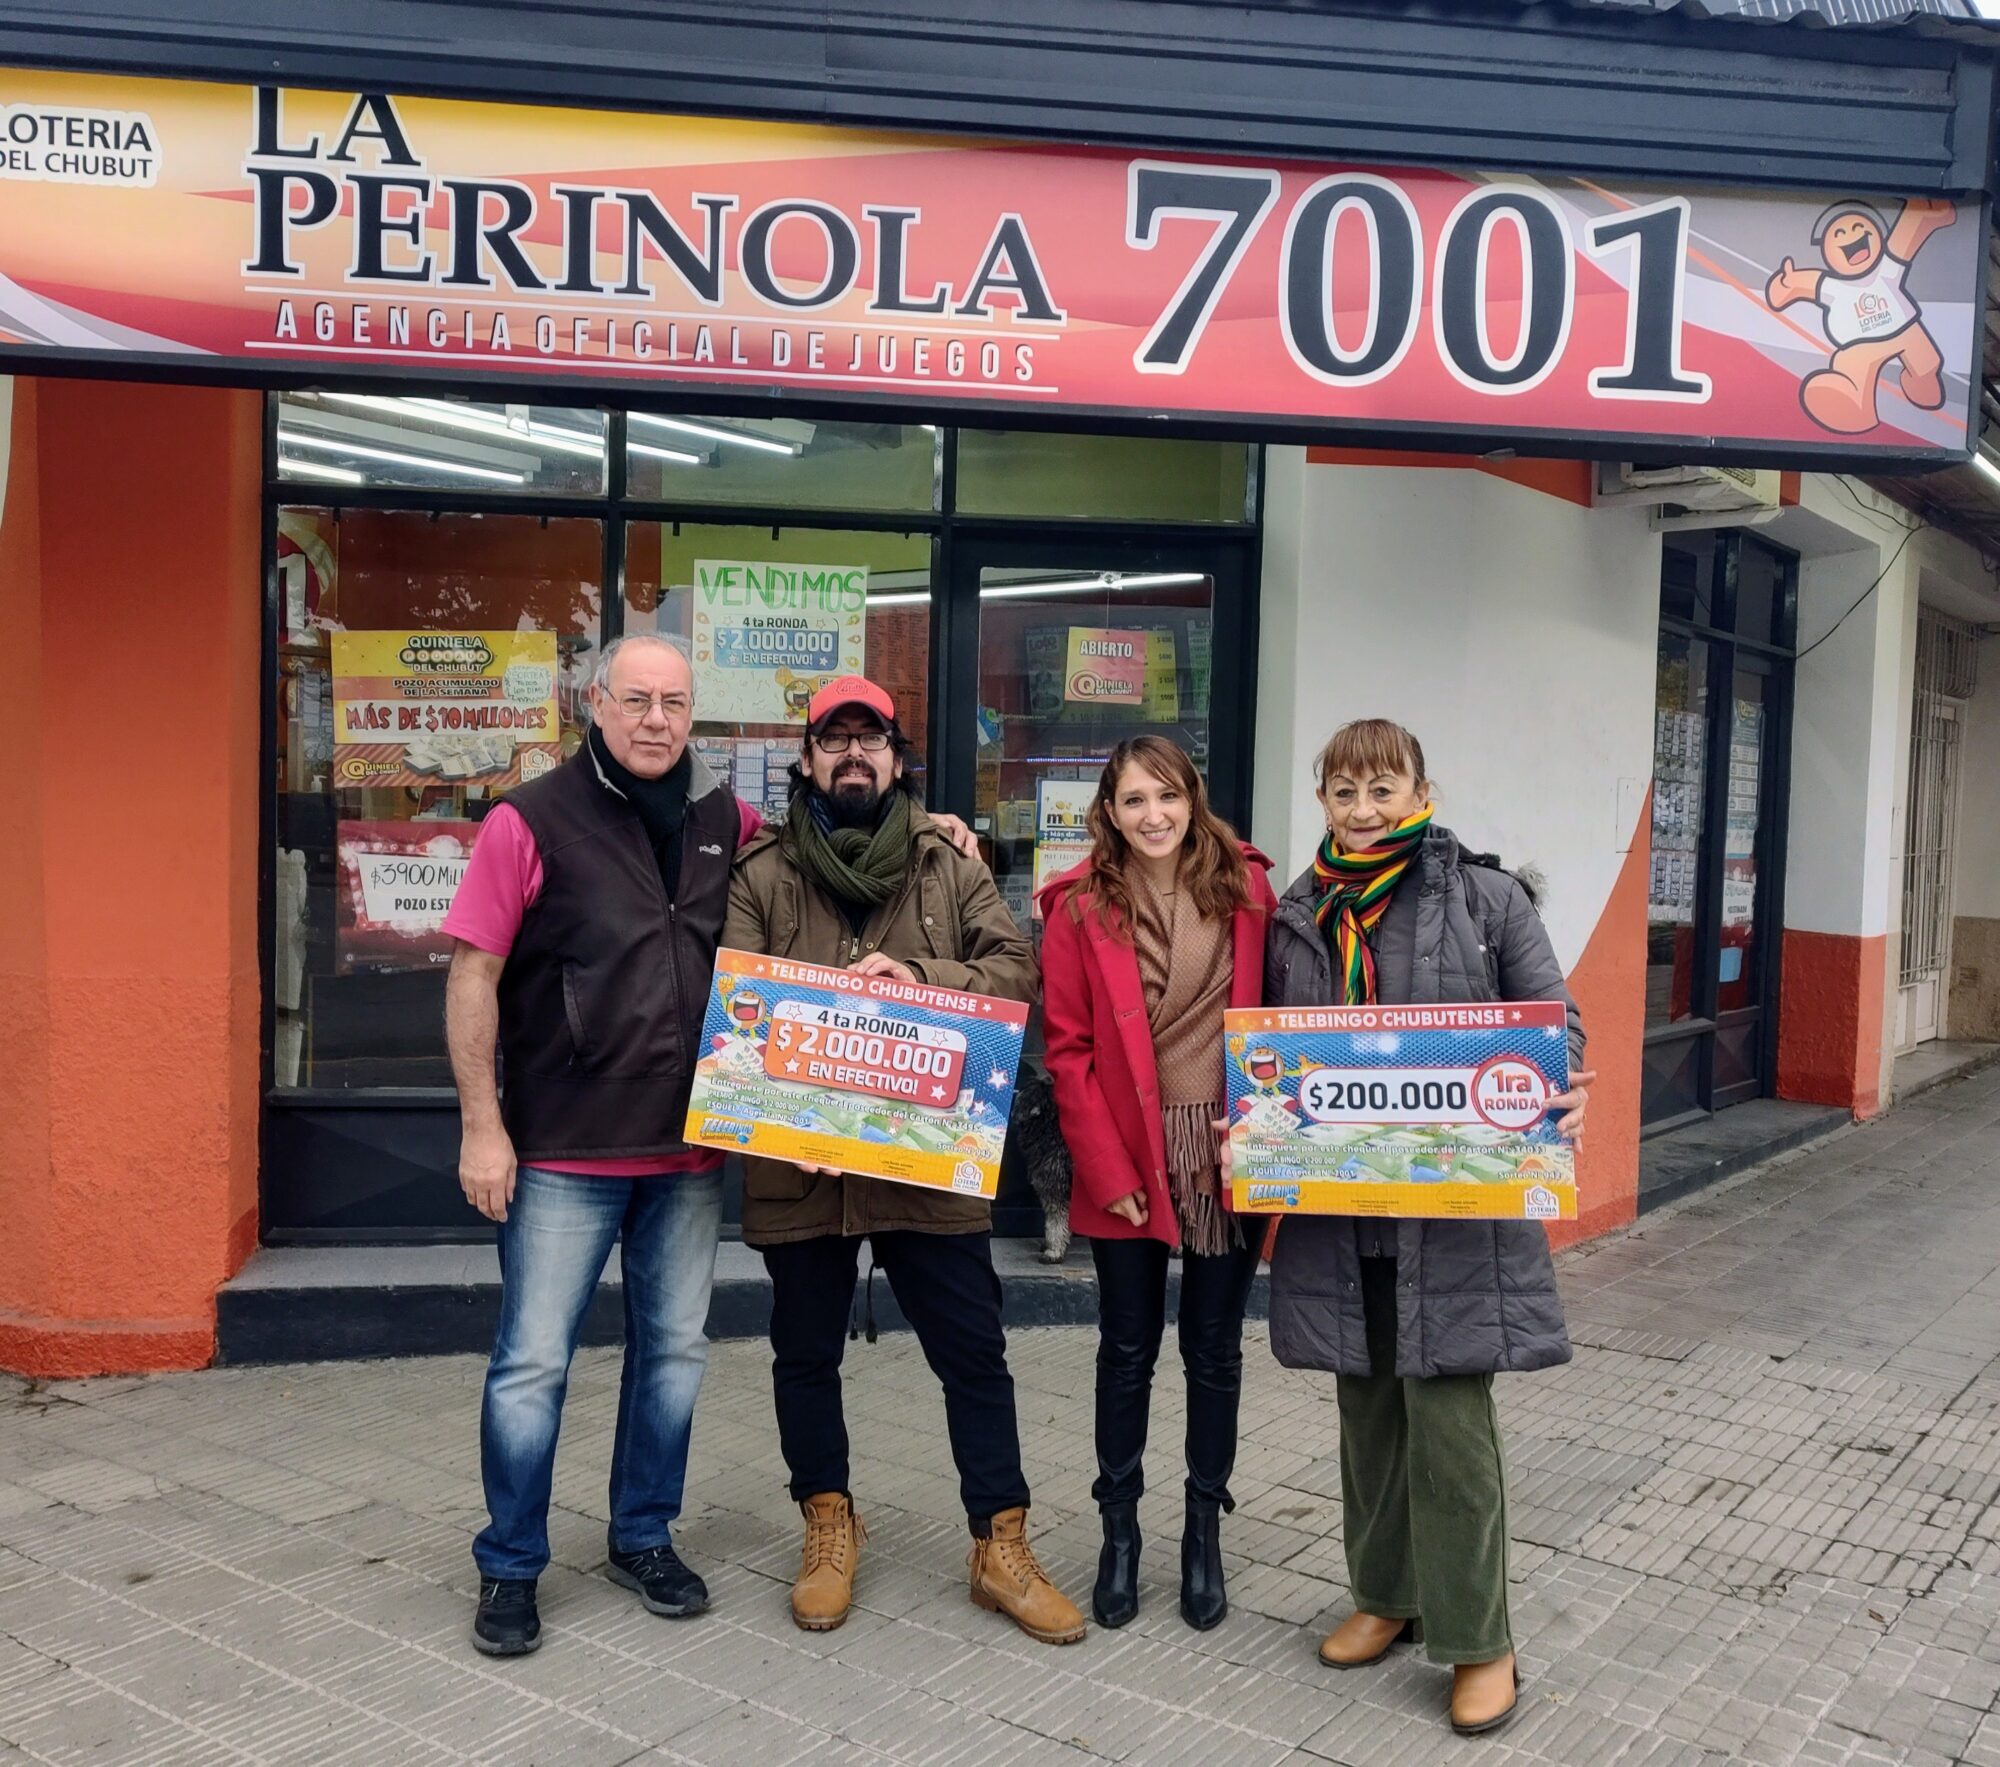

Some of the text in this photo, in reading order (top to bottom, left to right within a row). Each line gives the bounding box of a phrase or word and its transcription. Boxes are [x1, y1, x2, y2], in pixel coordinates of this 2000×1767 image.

[0, 113, 152, 151] OTERIA
[252, 86, 420, 166] LA
[45, 152, 152, 178] CHUBUT
[245, 167, 1063, 321] PERINOLA
[1134, 167, 1705, 394] 7001
[1859, 310, 1891, 328] LOTERIA
[276, 299, 1034, 382] AGENCIA OFICIAL DE JUEGOS
[700, 565, 866, 613] VENDIMOS
[742, 617, 808, 628] 4 ta RONDA
[408, 636, 483, 648] QUINIELA
[716, 631, 834, 652] $ 2.000.000
[1080, 640, 1133, 657] ABIERTO
[413, 664, 482, 673] DEL CHUBUT
[743, 653, 813, 666] EN EFECTIVO!
[394, 679, 499, 688] POZO ACUMULADO
[404, 687, 489, 697] DE LA SEMANA
[1076, 673, 1133, 695] QUINIELA
[345, 702, 549, 733] MÁS DE $10 MILLONES
[371, 862, 435, 890] $3900
[395, 898, 427, 911] POZO
[770, 962, 978, 1013] TELEBINGO CHUBUTENSE
[817, 1009, 919, 1041] 4 ta RONDA
[1278, 1009, 1505, 1029] TELEBINGO CHUBUTENSE
[776, 1022, 952, 1079] $ 2.000.000
[808, 1063, 919, 1096] EN EFECTIVO!
[1491, 1069, 1532, 1093] 1ra
[707, 1101, 736, 1111] ESQUEL
[740, 1095, 761, 1105] BINGO
[763, 1087, 780, 1096] por
[782, 1091, 801, 1100] este
[847, 1103, 891, 1116] poseedor
[893, 1109, 908, 1119] del
[1309, 1081, 1467, 1111] $200.000
[1484, 1098, 1540, 1111] RONDA
[1281, 1156, 1301, 1164] BINGO
[1301, 1145, 1318, 1153] por
[1391, 1145, 1440, 1155] poseedor
[1442, 1144, 1456, 1154] del
[954, 1178, 980, 1187] LOTERIA
